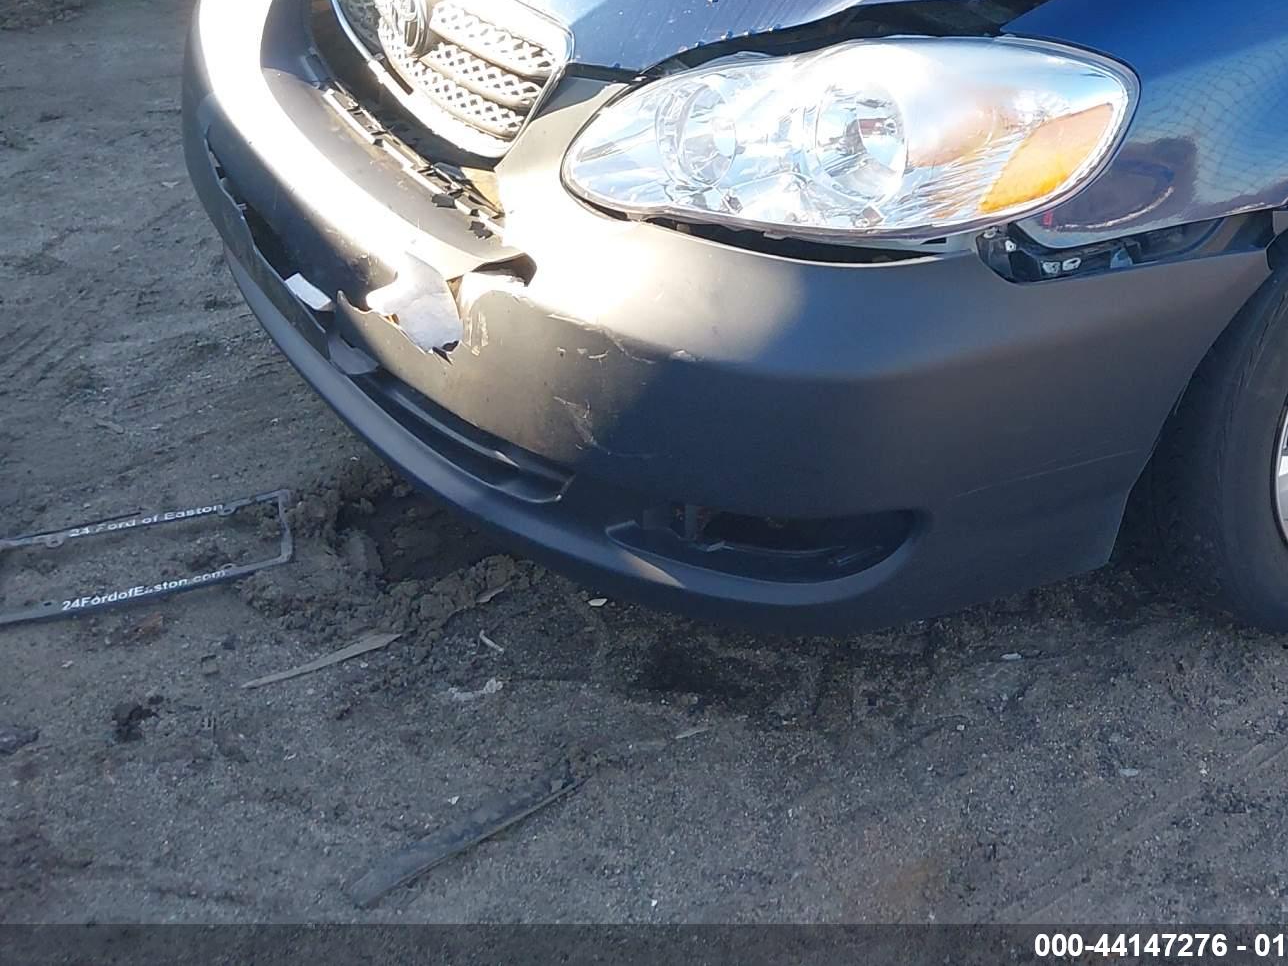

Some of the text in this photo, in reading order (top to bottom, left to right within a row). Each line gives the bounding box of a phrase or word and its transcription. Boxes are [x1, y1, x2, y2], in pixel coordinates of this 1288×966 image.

[69, 504, 224, 537] 24 Ford of Easton
